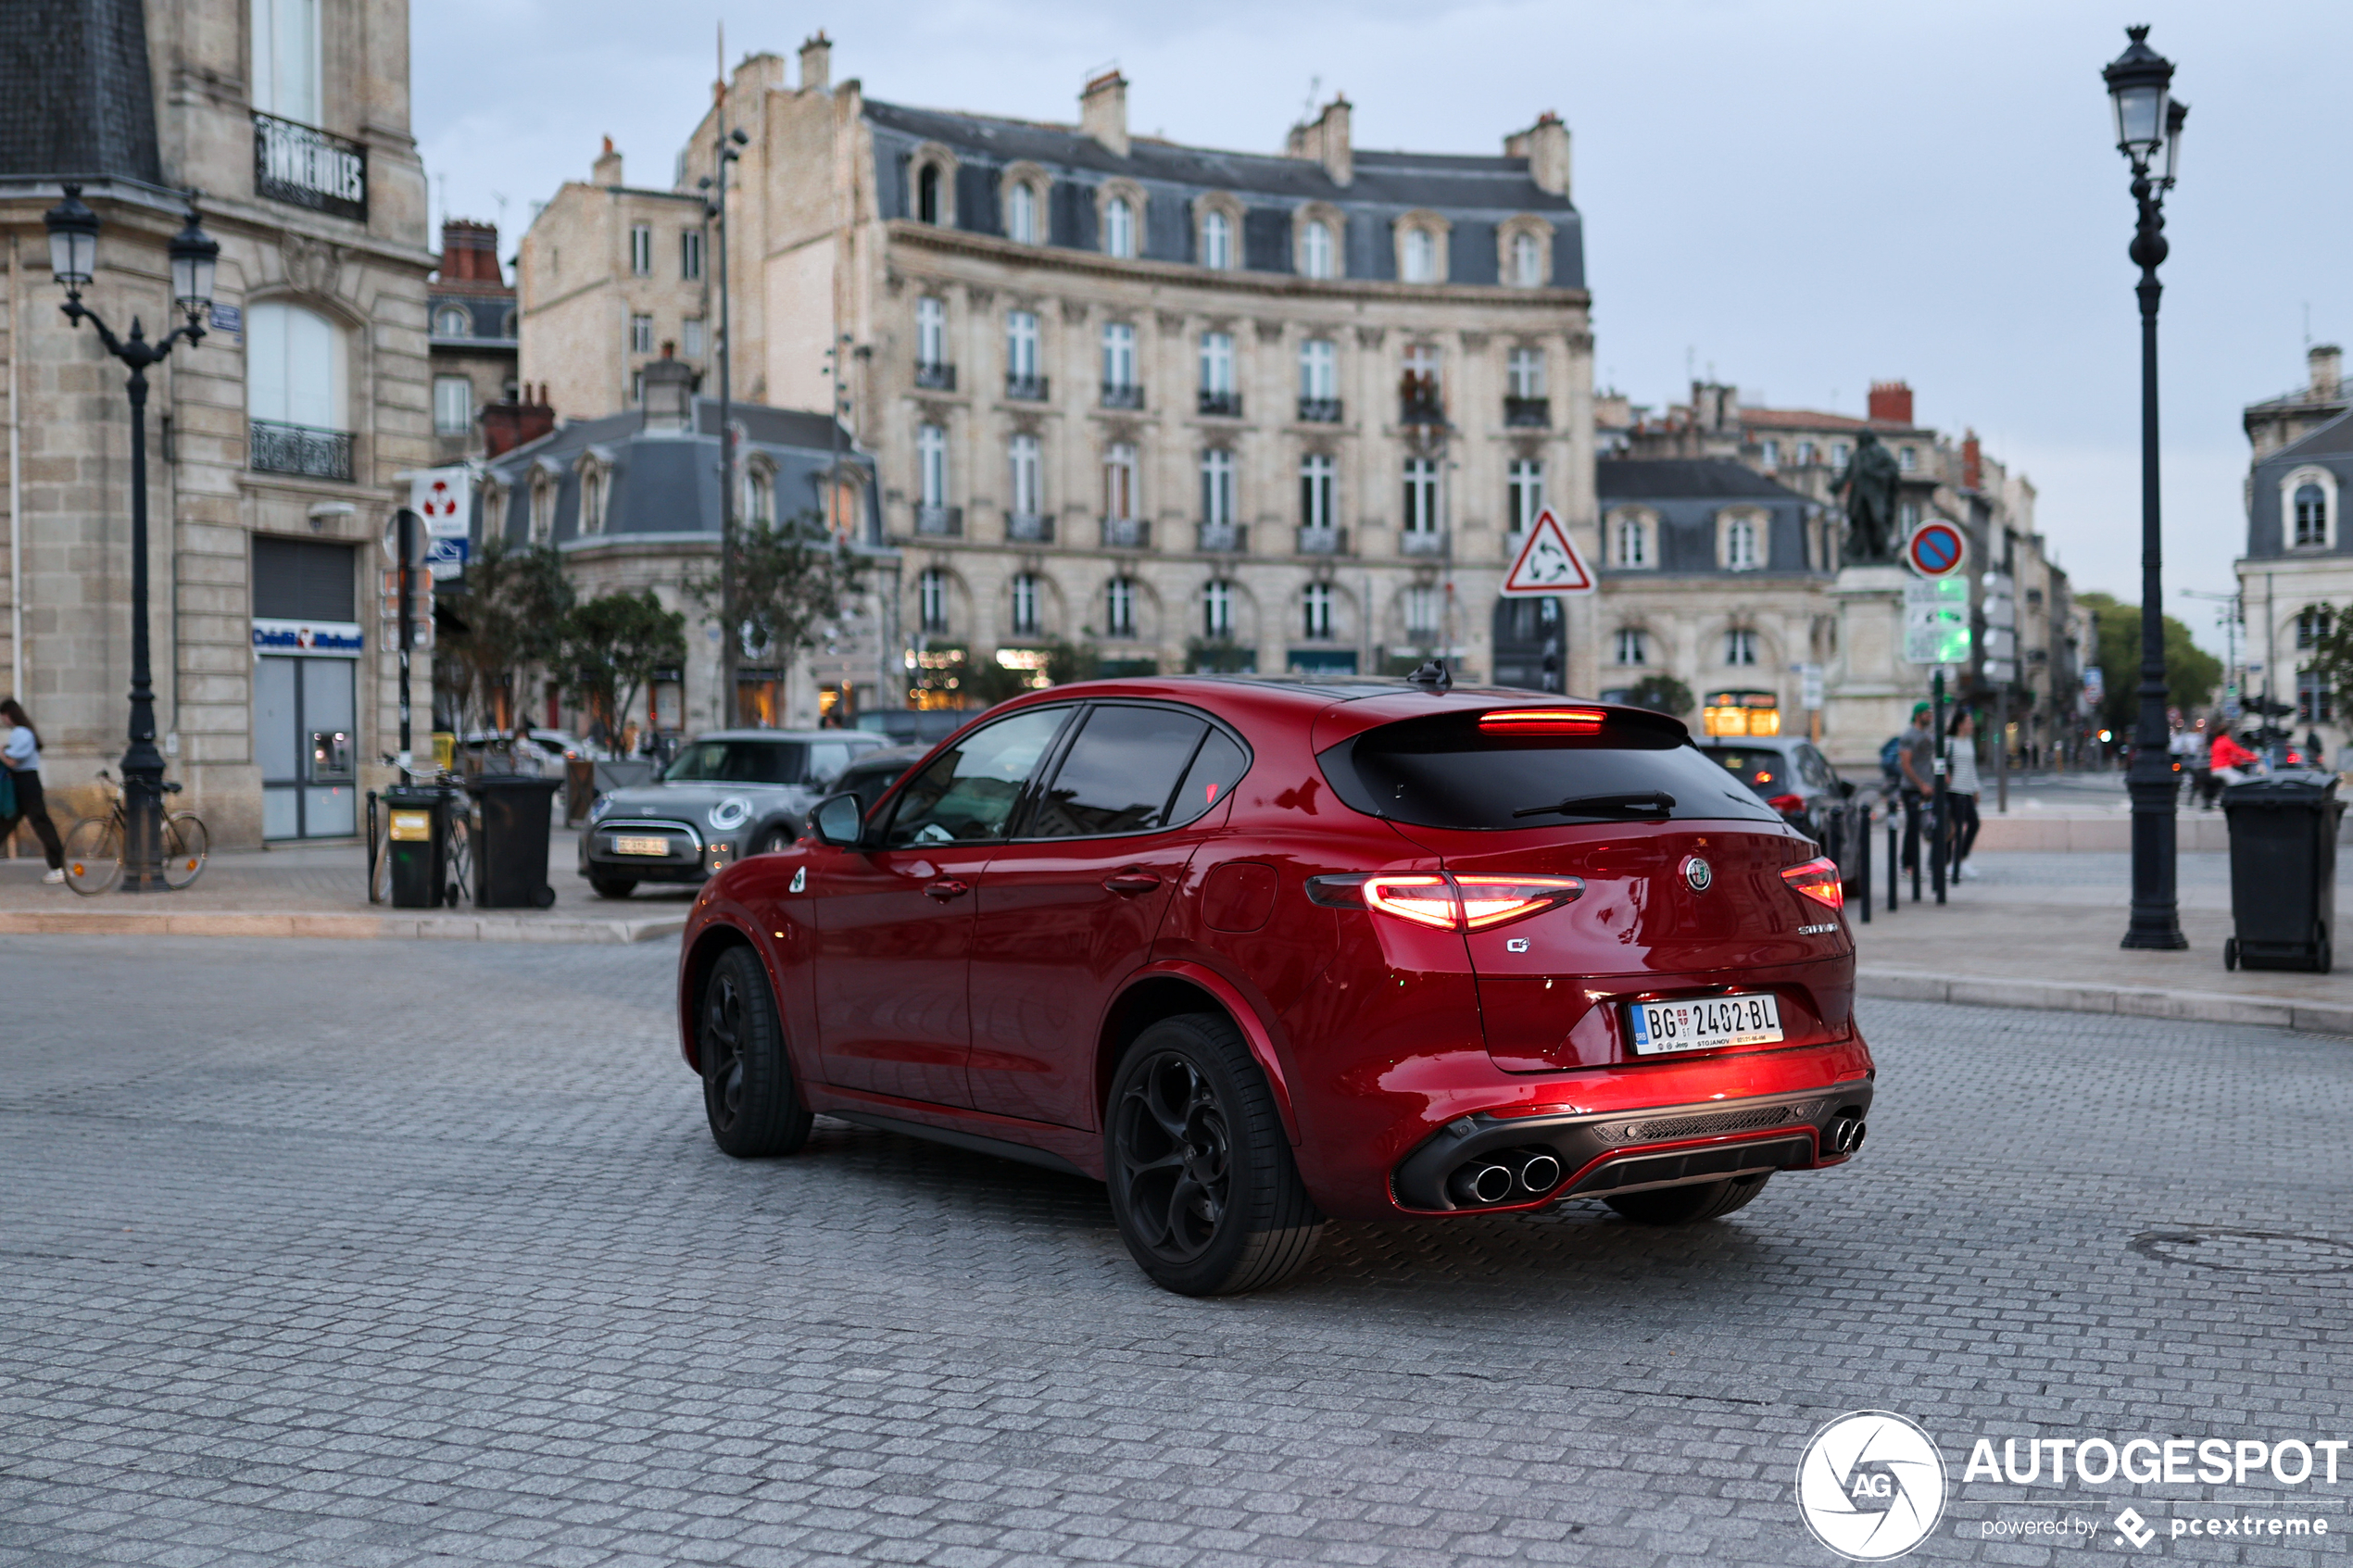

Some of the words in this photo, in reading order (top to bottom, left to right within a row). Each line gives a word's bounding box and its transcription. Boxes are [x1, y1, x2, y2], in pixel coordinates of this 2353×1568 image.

[1506, 937, 1530, 953] Q4
[1648, 1008, 1676, 1039] BG
[1635, 1032, 1647, 1042] SRB
[1697, 1038, 1730, 1047] STOJANOV
